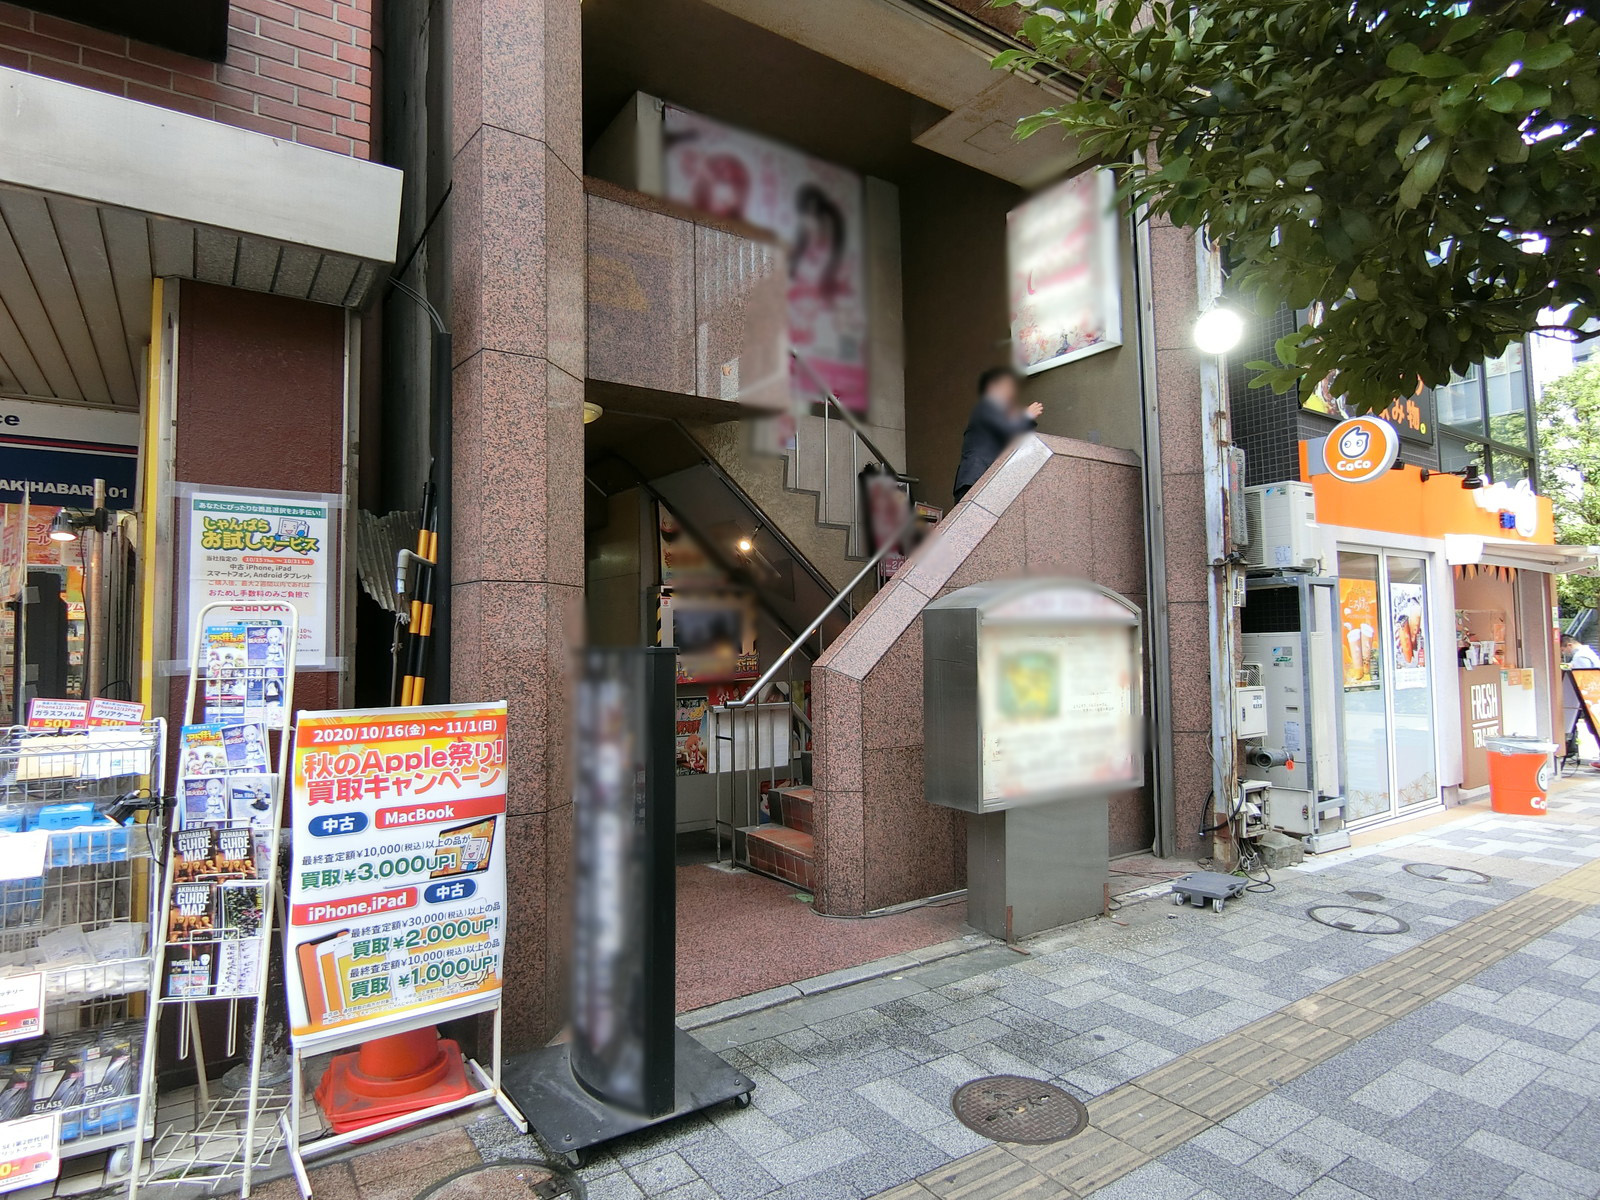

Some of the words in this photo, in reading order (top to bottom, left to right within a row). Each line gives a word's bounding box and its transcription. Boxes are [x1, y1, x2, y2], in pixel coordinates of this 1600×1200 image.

[0, 414, 20, 426] e
[1337, 460, 1371, 471] CoCo
[0, 480, 106, 497] AKIHABAR
[109, 488, 127, 498] 01
[201, 530, 320, 551] お試しサービス
[1471, 683, 1498, 720] FRESH
[97, 710, 136, 719] クリアケース
[304, 739, 505, 781] 秋のApple祭り!
[307, 767, 501, 806] 買取キャンペーン
[322, 816, 355, 833] 中古
[385, 805, 455, 825] MacBook
[178, 830, 211, 840] AKIHABARA
[220, 830, 249, 840] AKIHABARA
[180, 837, 212, 851] GUIDE
[220, 836, 250, 851] GUIDE
[177, 885, 210, 893] AKIHABARA
[436, 882, 465, 899] 中古
[177, 892, 210, 905] GUIDE
[308, 892, 407, 922] iPhone,iPad
[86, 1085, 114, 1097] GLASS
[34, 1101, 62, 1111] GLASS
